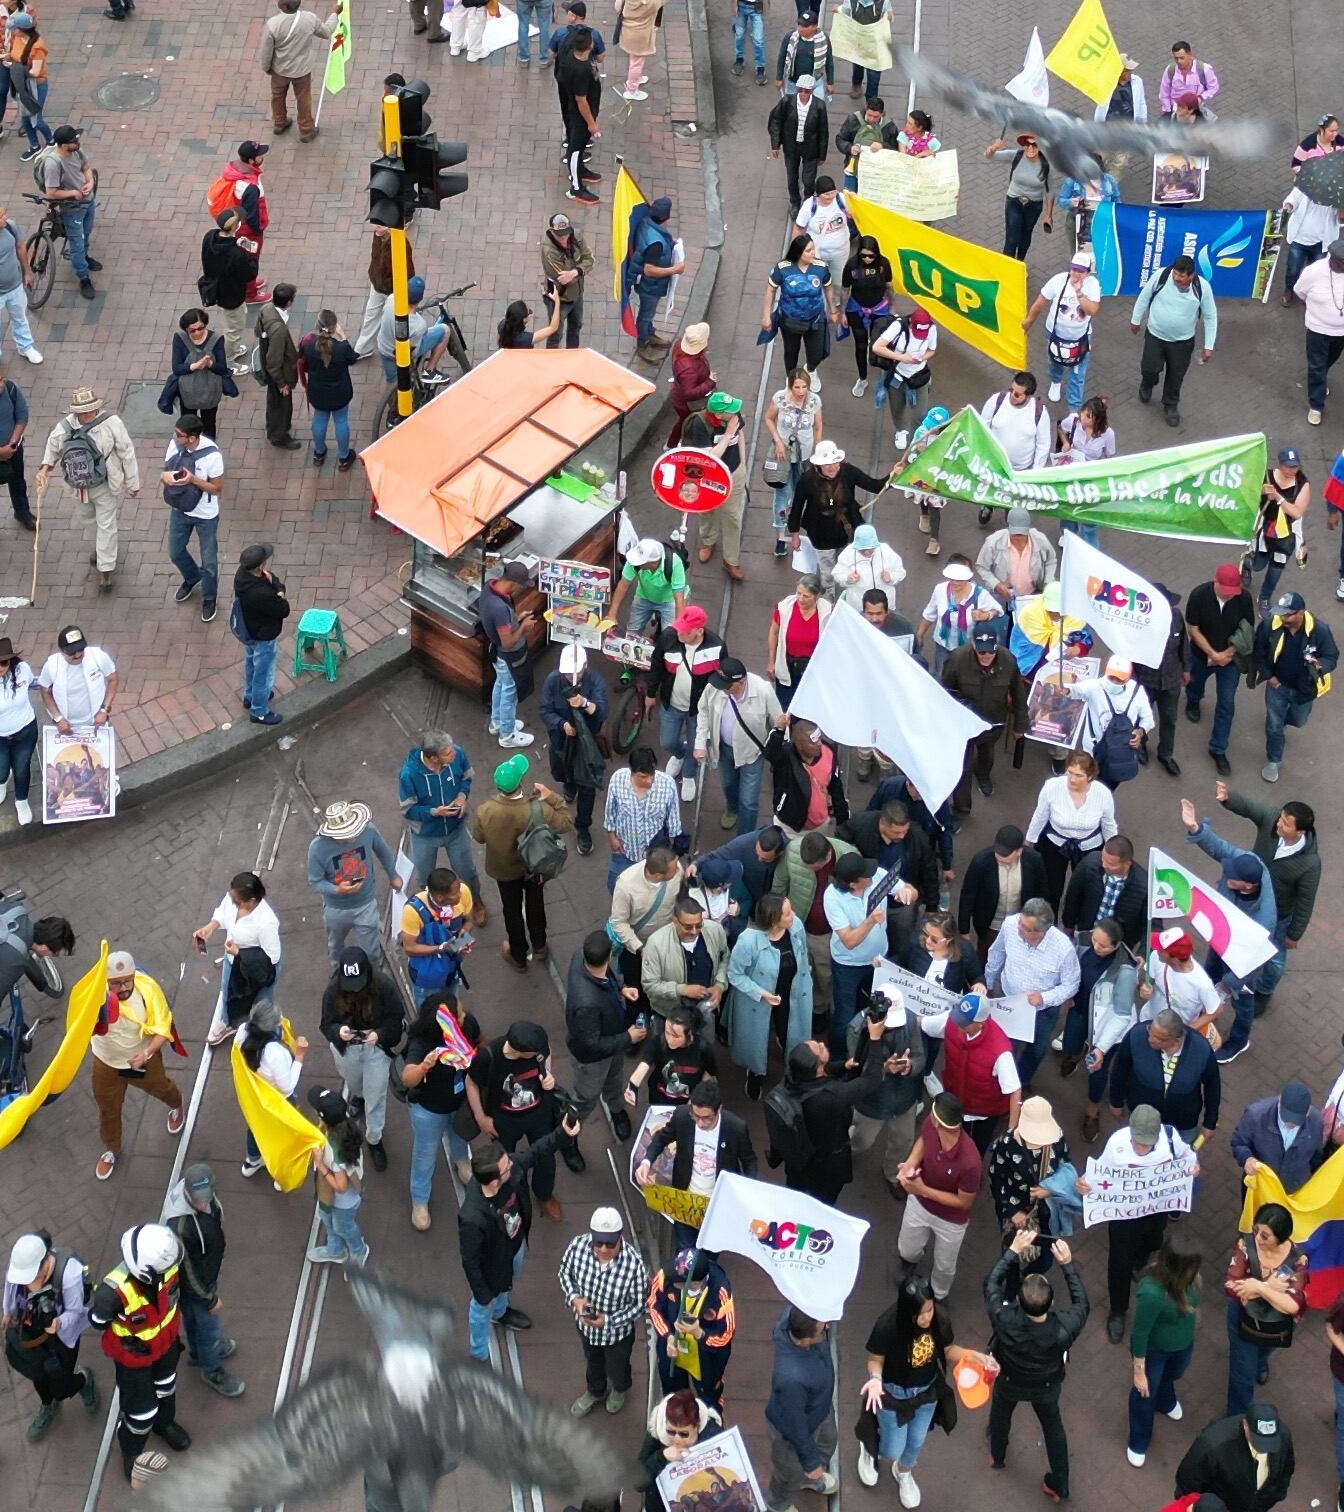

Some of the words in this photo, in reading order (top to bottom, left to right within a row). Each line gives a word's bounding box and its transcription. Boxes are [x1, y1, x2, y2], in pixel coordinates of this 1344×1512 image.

[909, 260, 982, 313] UP
[1067, 480, 1100, 505] de
[1174, 487, 1192, 506] la
[1197, 491, 1239, 511] vida.
[540, 561, 594, 580] PETRO
[1086, 575, 1152, 615] PACTO
[1094, 1161, 1147, 1179] HAMBRE
[1153, 1157, 1188, 1175] CERO
[750, 1218, 834, 1255] PACTO
